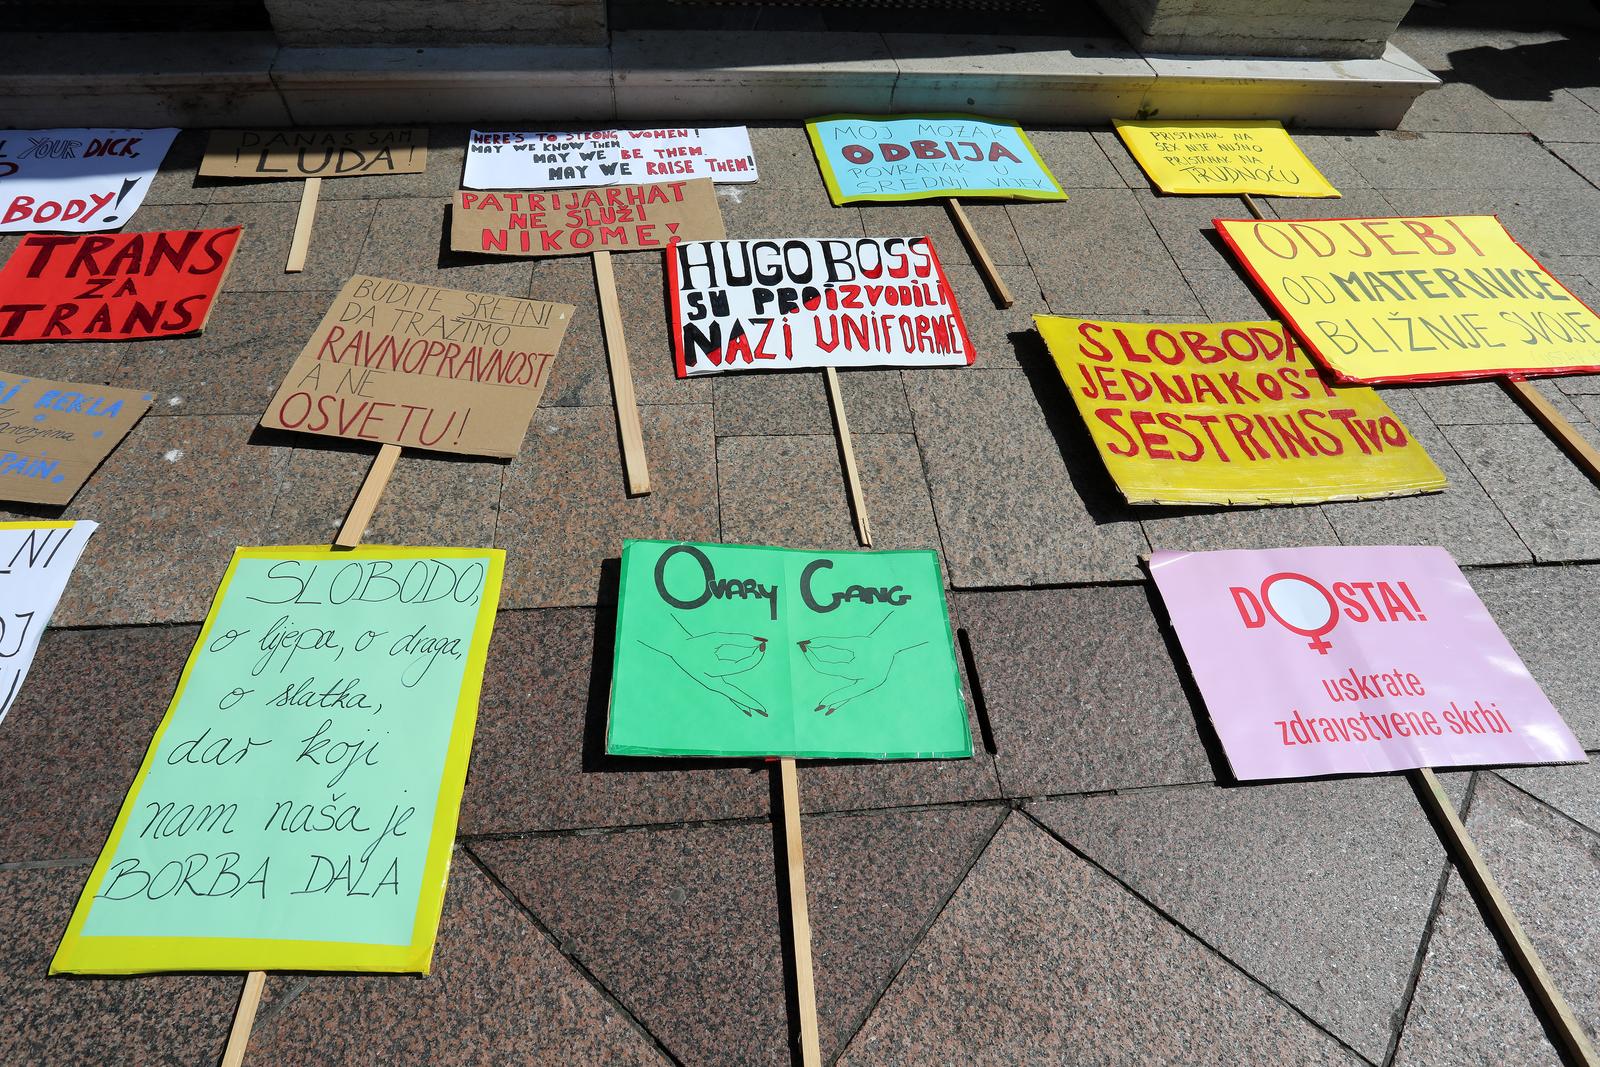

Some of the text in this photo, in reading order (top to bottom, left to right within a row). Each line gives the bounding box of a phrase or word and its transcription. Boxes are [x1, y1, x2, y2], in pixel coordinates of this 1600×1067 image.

[17, 137, 82, 159] YOUR
[83, 137, 143, 158] DICK,
[242, 130, 412, 147] DANAS SAM
[471, 144, 503, 153] MAY
[513, 143, 536, 151] WE
[543, 142, 584, 151] KNOW
[474, 133, 525, 144] HERE'S
[536, 133, 557, 142] TO
[566, 131, 618, 141] STRONG
[834, 124, 1009, 141] MOJ MOZAK
[1150, 131, 1253, 144] PRISTANAK NA
[1155, 142, 1178, 152] SEX
[1185, 142, 1210, 152] NIJE
[533, 152, 570, 163] MAY
[579, 150, 606, 161] WE
[620, 148, 644, 160] BE
[548, 165, 588, 180] MAY
[599, 162, 632, 176] WE
[646, 160, 694, 175] RAISE
[841, 140, 1023, 165] ODBIJA
[847, 162, 1010, 180] POVRATAK U
[1163, 154, 1264, 167] PRISTANAK NA
[855, 176, 1050, 194] SREDNJI VIJEK
[1178, 165, 1300, 185] TRUDNOĆU
[1, 176, 142, 224] BODY!
[461, 181, 687, 211] PATRIJARHAT
[508, 203, 647, 230] NE SLUŽI
[24, 229, 240, 279] TRANS
[1253, 219, 1486, 260] ODJEBI
[678, 237, 931, 291] HUGO BOSS
[73, 277, 138, 300] ZA
[352, 279, 553, 327] BUDITE SRETNI
[686, 279, 948, 321] SU PROIZVODILI
[1281, 266, 1572, 306] OD MATERNICE
[0, 294, 207, 339] TRANS
[339, 301, 377, 327] DA
[1315, 311, 1600, 355] BLIŽNJE SVOJE
[316, 325, 555, 388] RAVNOPRAVNOST
[682, 311, 963, 368] NAZI UNIFORME
[1078, 322, 1300, 366] SLOBODA
[297, 363, 386, 398] A NE
[1077, 361, 1336, 405] JEDNAKOST
[278, 392, 471, 447] OSVETU!
[246, 559, 484, 607] SLOBODO,
[1229, 572, 1428, 648] DOSTA!
[209, 615, 463, 688] o ljepa, o draga,
[218, 677, 383, 715] o slatka,
[1322, 667, 1426, 703] uskrate
[1274, 701, 1512, 747] zdravstvene skrbi
[166, 719, 390, 788] dar koji
[140, 790, 416, 863] nam naša je
[92, 852, 399, 901] BORBA DALA
